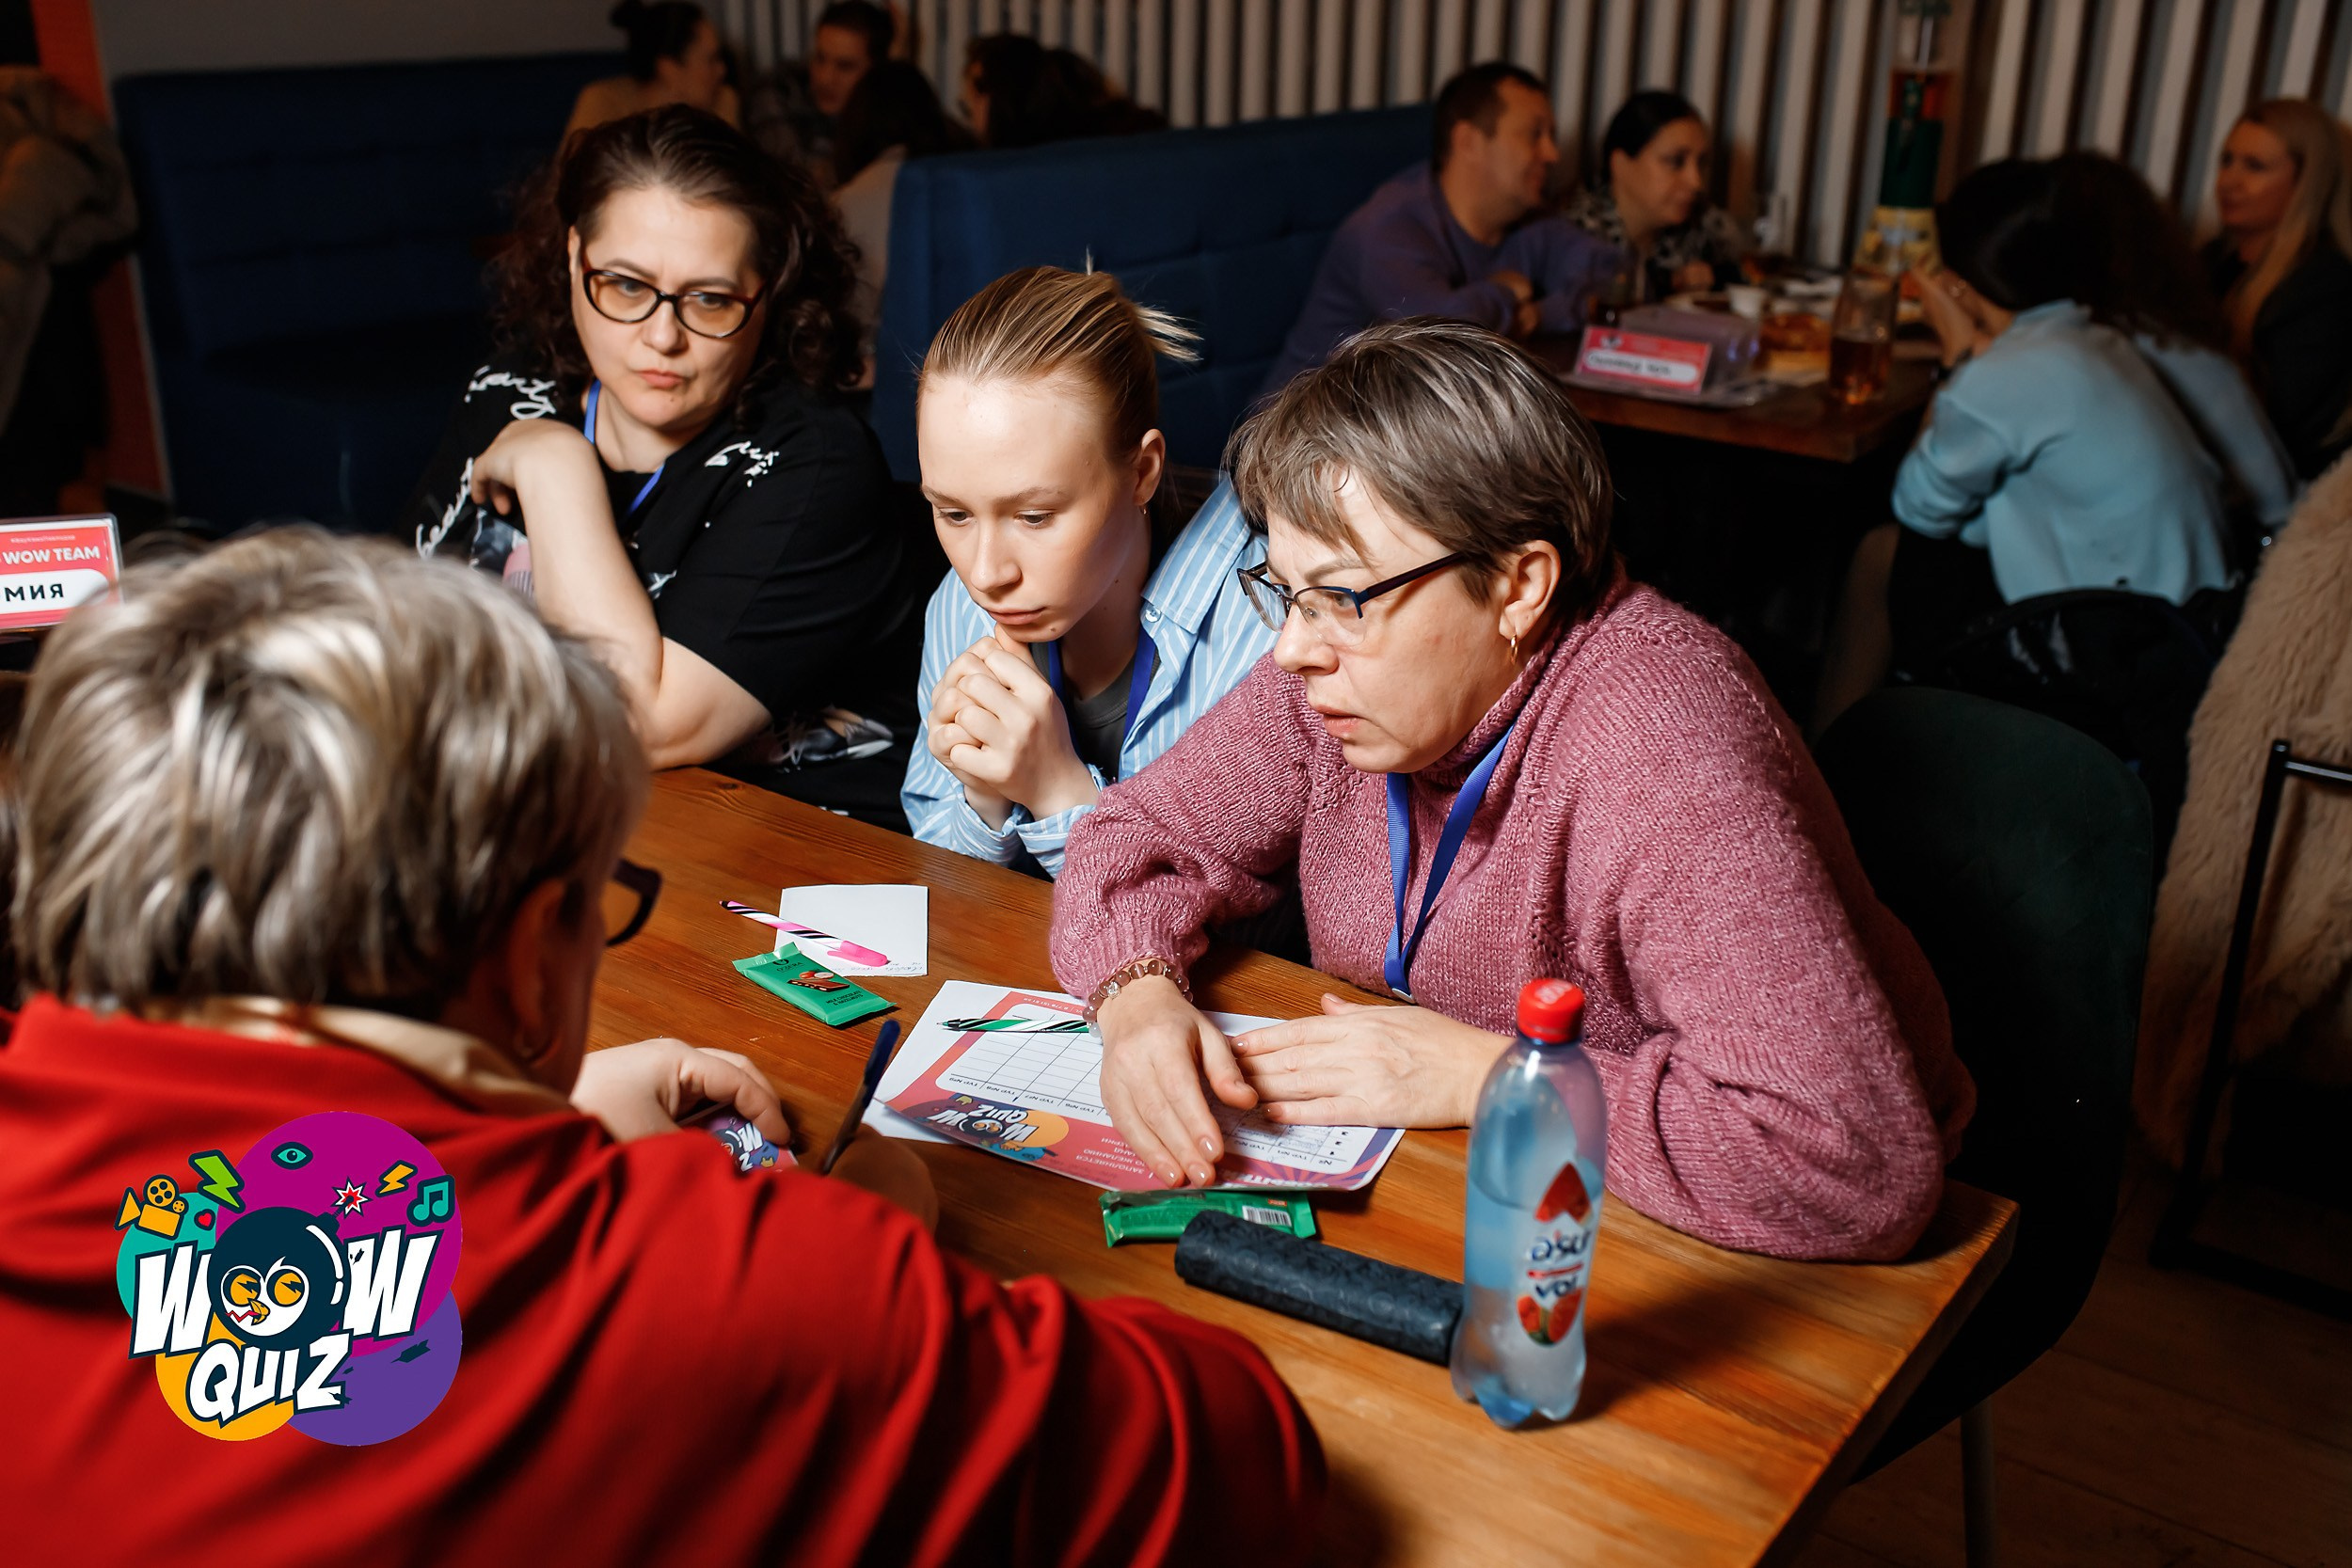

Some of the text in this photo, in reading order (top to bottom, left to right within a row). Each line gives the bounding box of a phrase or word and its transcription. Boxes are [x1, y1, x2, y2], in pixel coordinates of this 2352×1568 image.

[3, 546, 101, 564] WOW TEAM
[968, 1102, 1028, 1124] QUIZ
[927, 1109, 1040, 1143] WOW
[1075, 1154, 1145, 1175] ЗАПОЛНЯЕТСЯ
[1084, 1148, 1134, 1164] ЖЕЛАНИЮ
